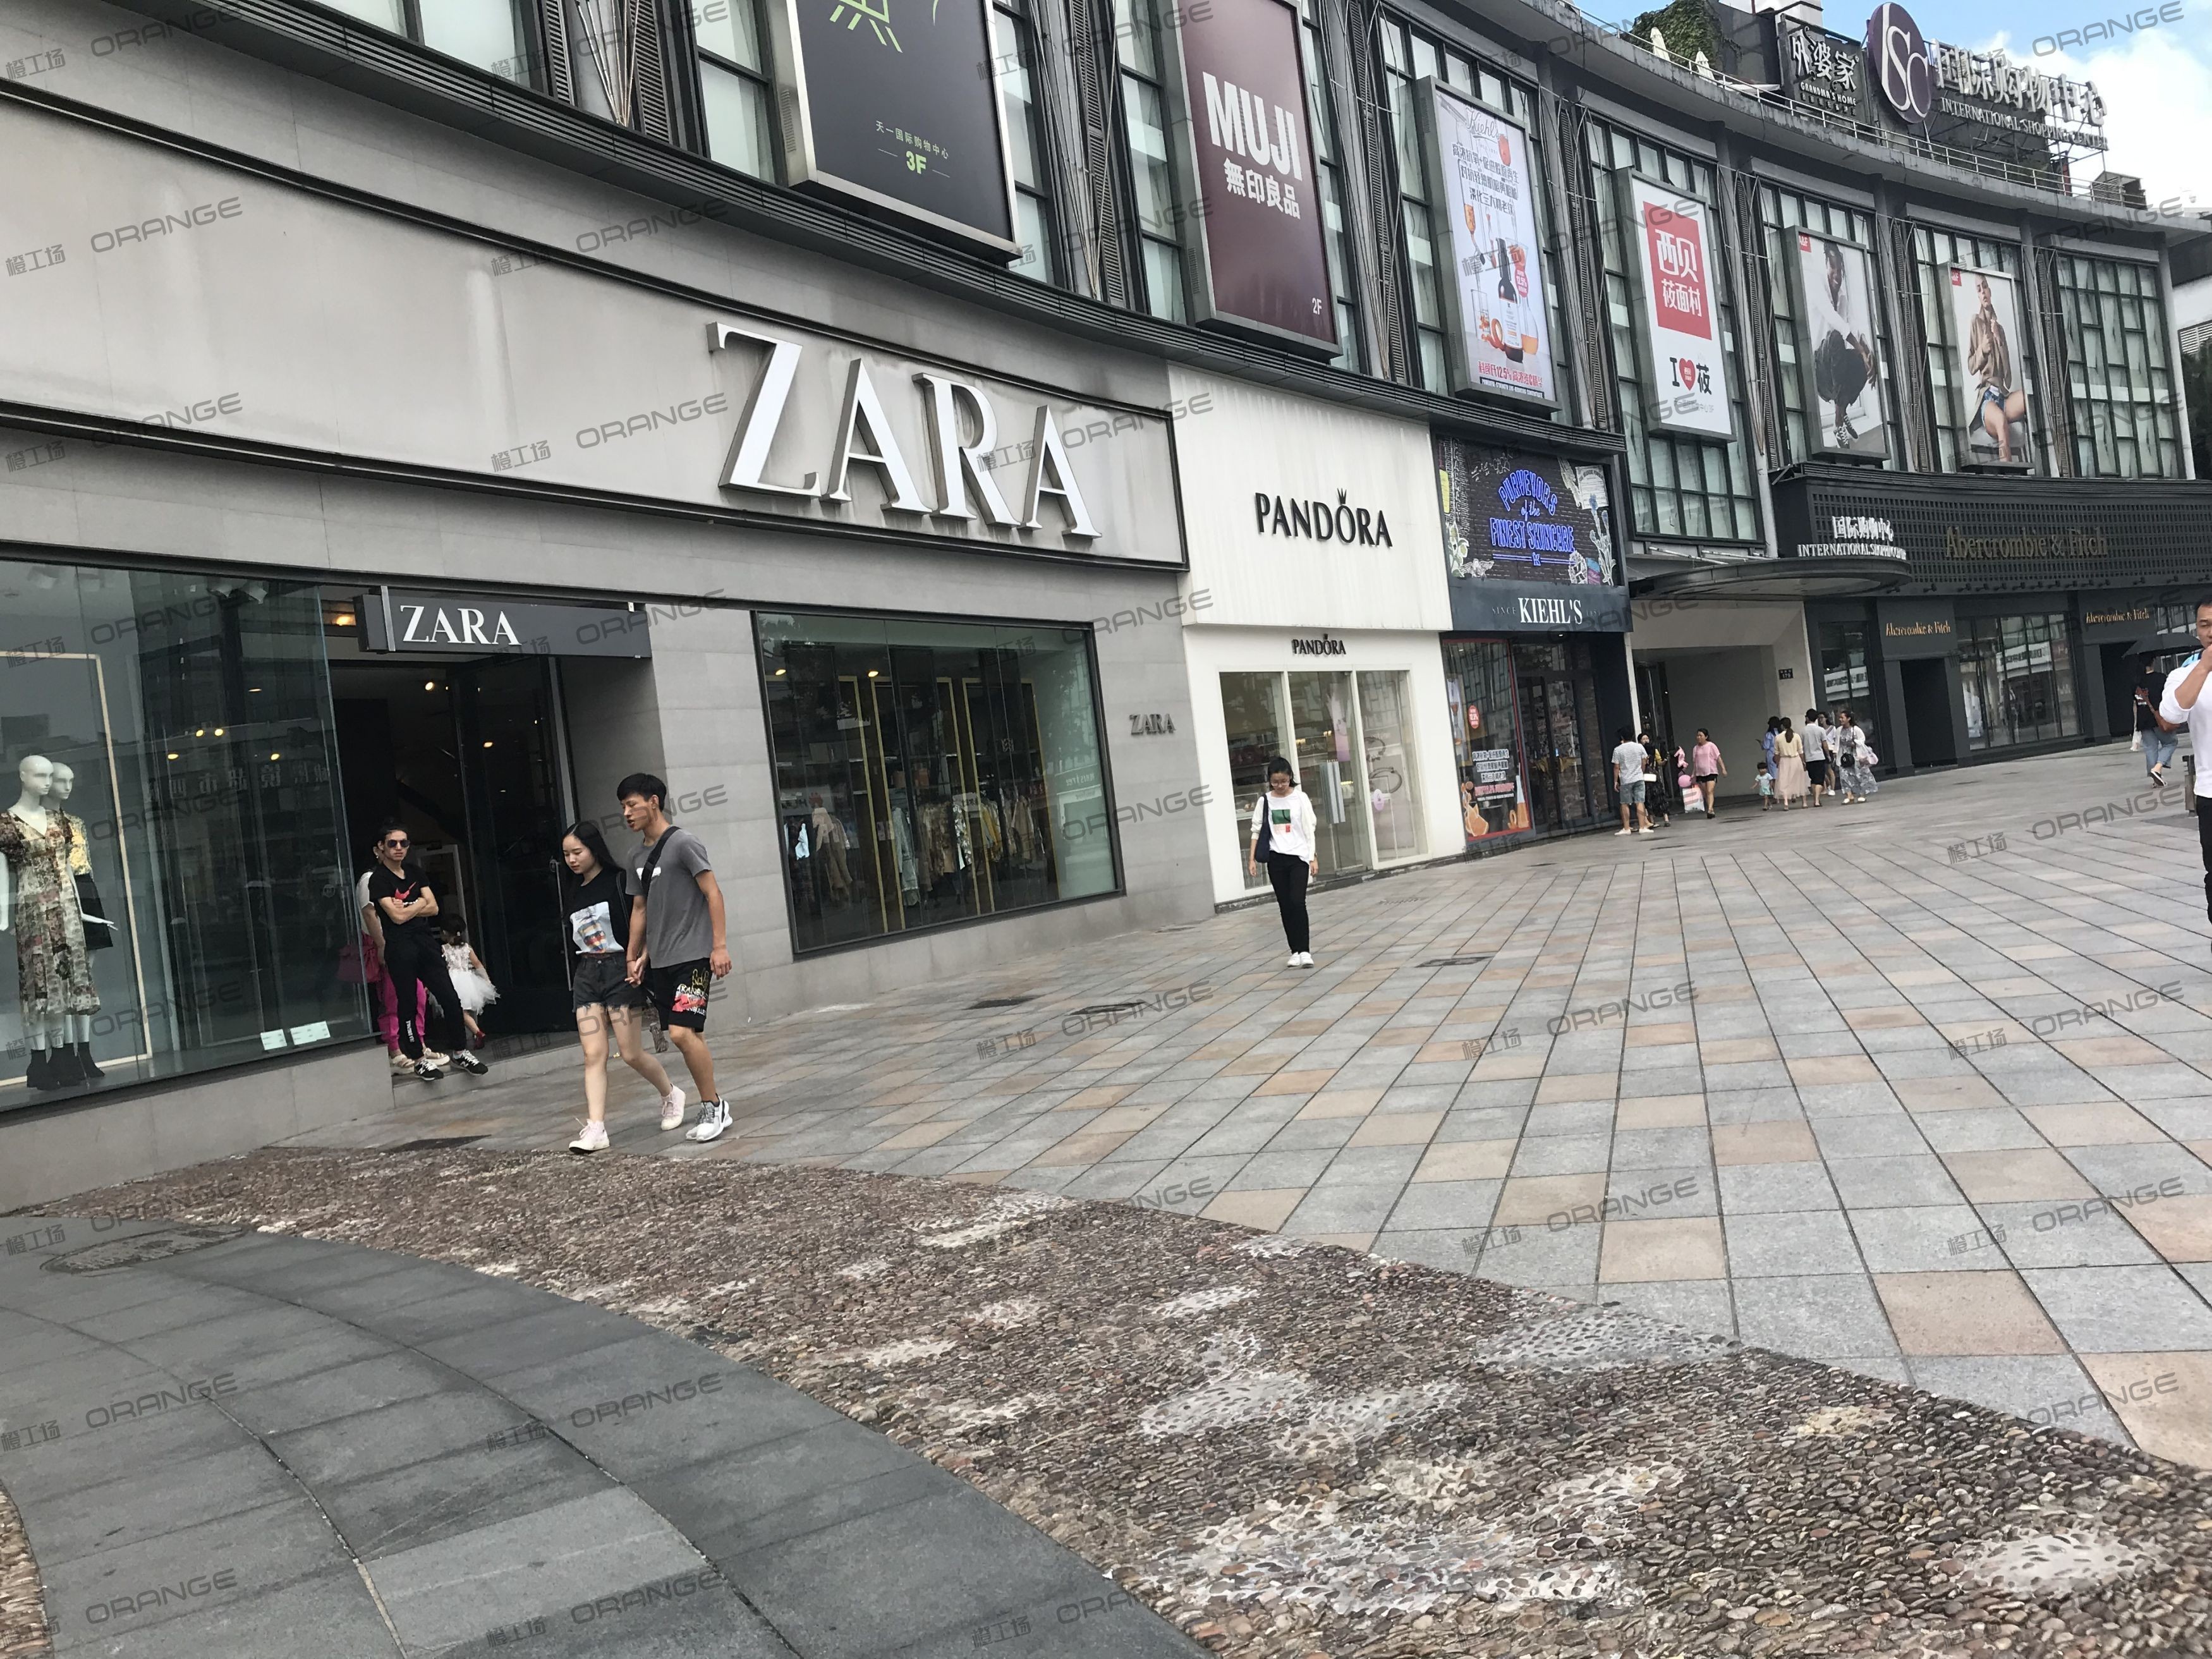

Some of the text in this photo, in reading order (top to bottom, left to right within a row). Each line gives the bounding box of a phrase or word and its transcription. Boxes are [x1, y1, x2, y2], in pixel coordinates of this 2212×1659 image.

[1791, 27, 1857, 92] 外婆家
[1801, 82, 1835, 100] GRANDMA'S
[1837, 94, 1856, 106] HOME
[1203, 71, 1303, 181] MUJI
[1941, 97, 2021, 131] INTERNATIONAL
[2022, 119, 2069, 142] SHOPPING
[875, 120, 949, 160] 天一国际购物中心
[906, 151, 927, 174] 3F
[1222, 157, 1301, 220] 無印良品
[1655, 228, 1698, 283] 西贝
[1311, 297, 1322, 315] 2F
[1661, 278, 1702, 317] 莜面村
[1670, 357, 1680, 387] I
[1696, 363, 1711, 395] 莜
[705, 321, 1103, 539] ZARA
[1498, 469, 1558, 516] PURVEYORS
[1255, 489, 1393, 547] PANDORA
[1490, 517, 1575, 552] FINEST SKINCARE
[1797, 543, 1870, 557] INTERNATIONAL
[1946, 526, 2047, 559] Abercrombie
[399, 605, 522, 646] ZARA
[1518, 597, 1583, 624] KIEHL'S
[1292, 636, 1346, 656] PANDORA
[1129, 713, 1176, 735] ZARA
